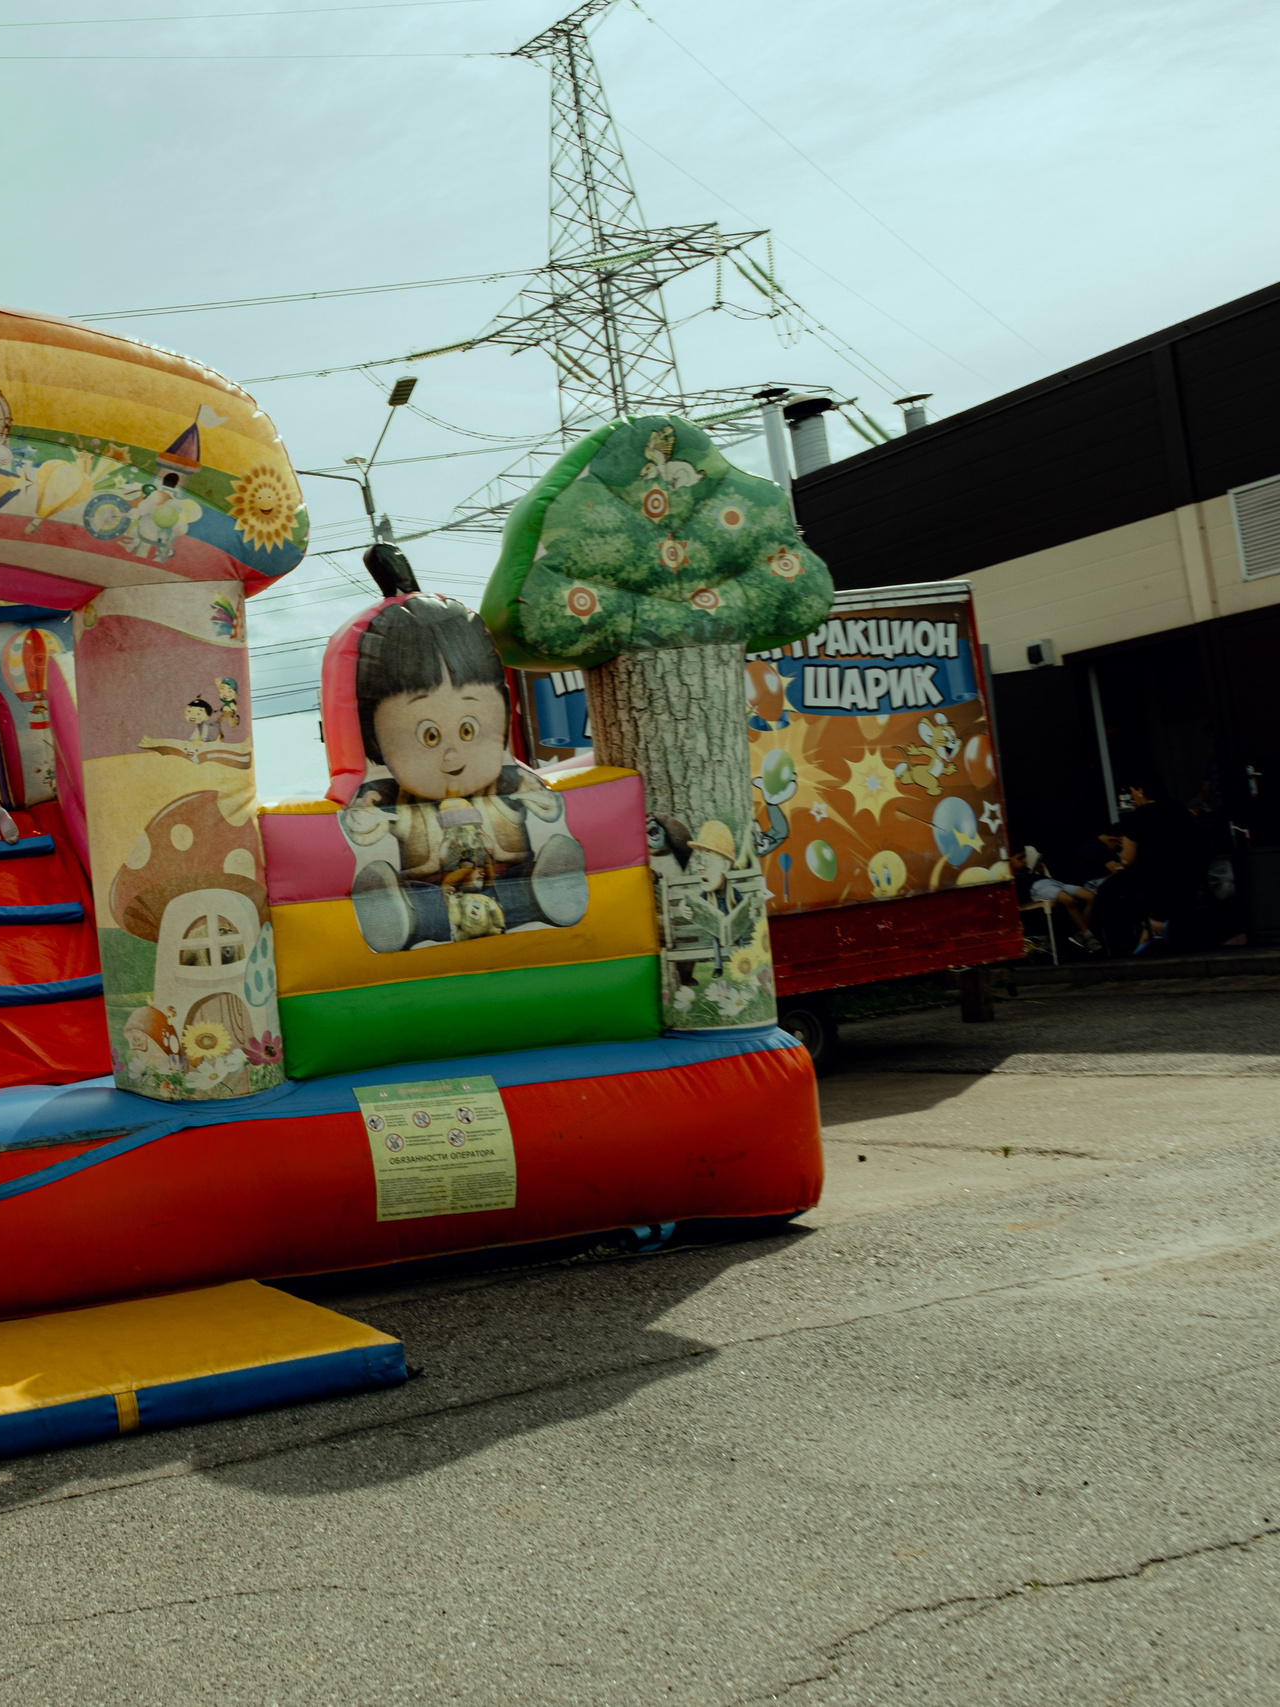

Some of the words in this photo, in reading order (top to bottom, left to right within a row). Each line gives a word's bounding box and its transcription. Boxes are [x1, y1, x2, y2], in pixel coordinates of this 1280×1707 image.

[745, 618, 958, 661] РАКЦИОН
[803, 663, 944, 710] ШАРИК
[389, 1153, 448, 1165] ОБЯЗАННОСТИ
[451, 1150, 496, 1160] ОПЕРАТОРА
